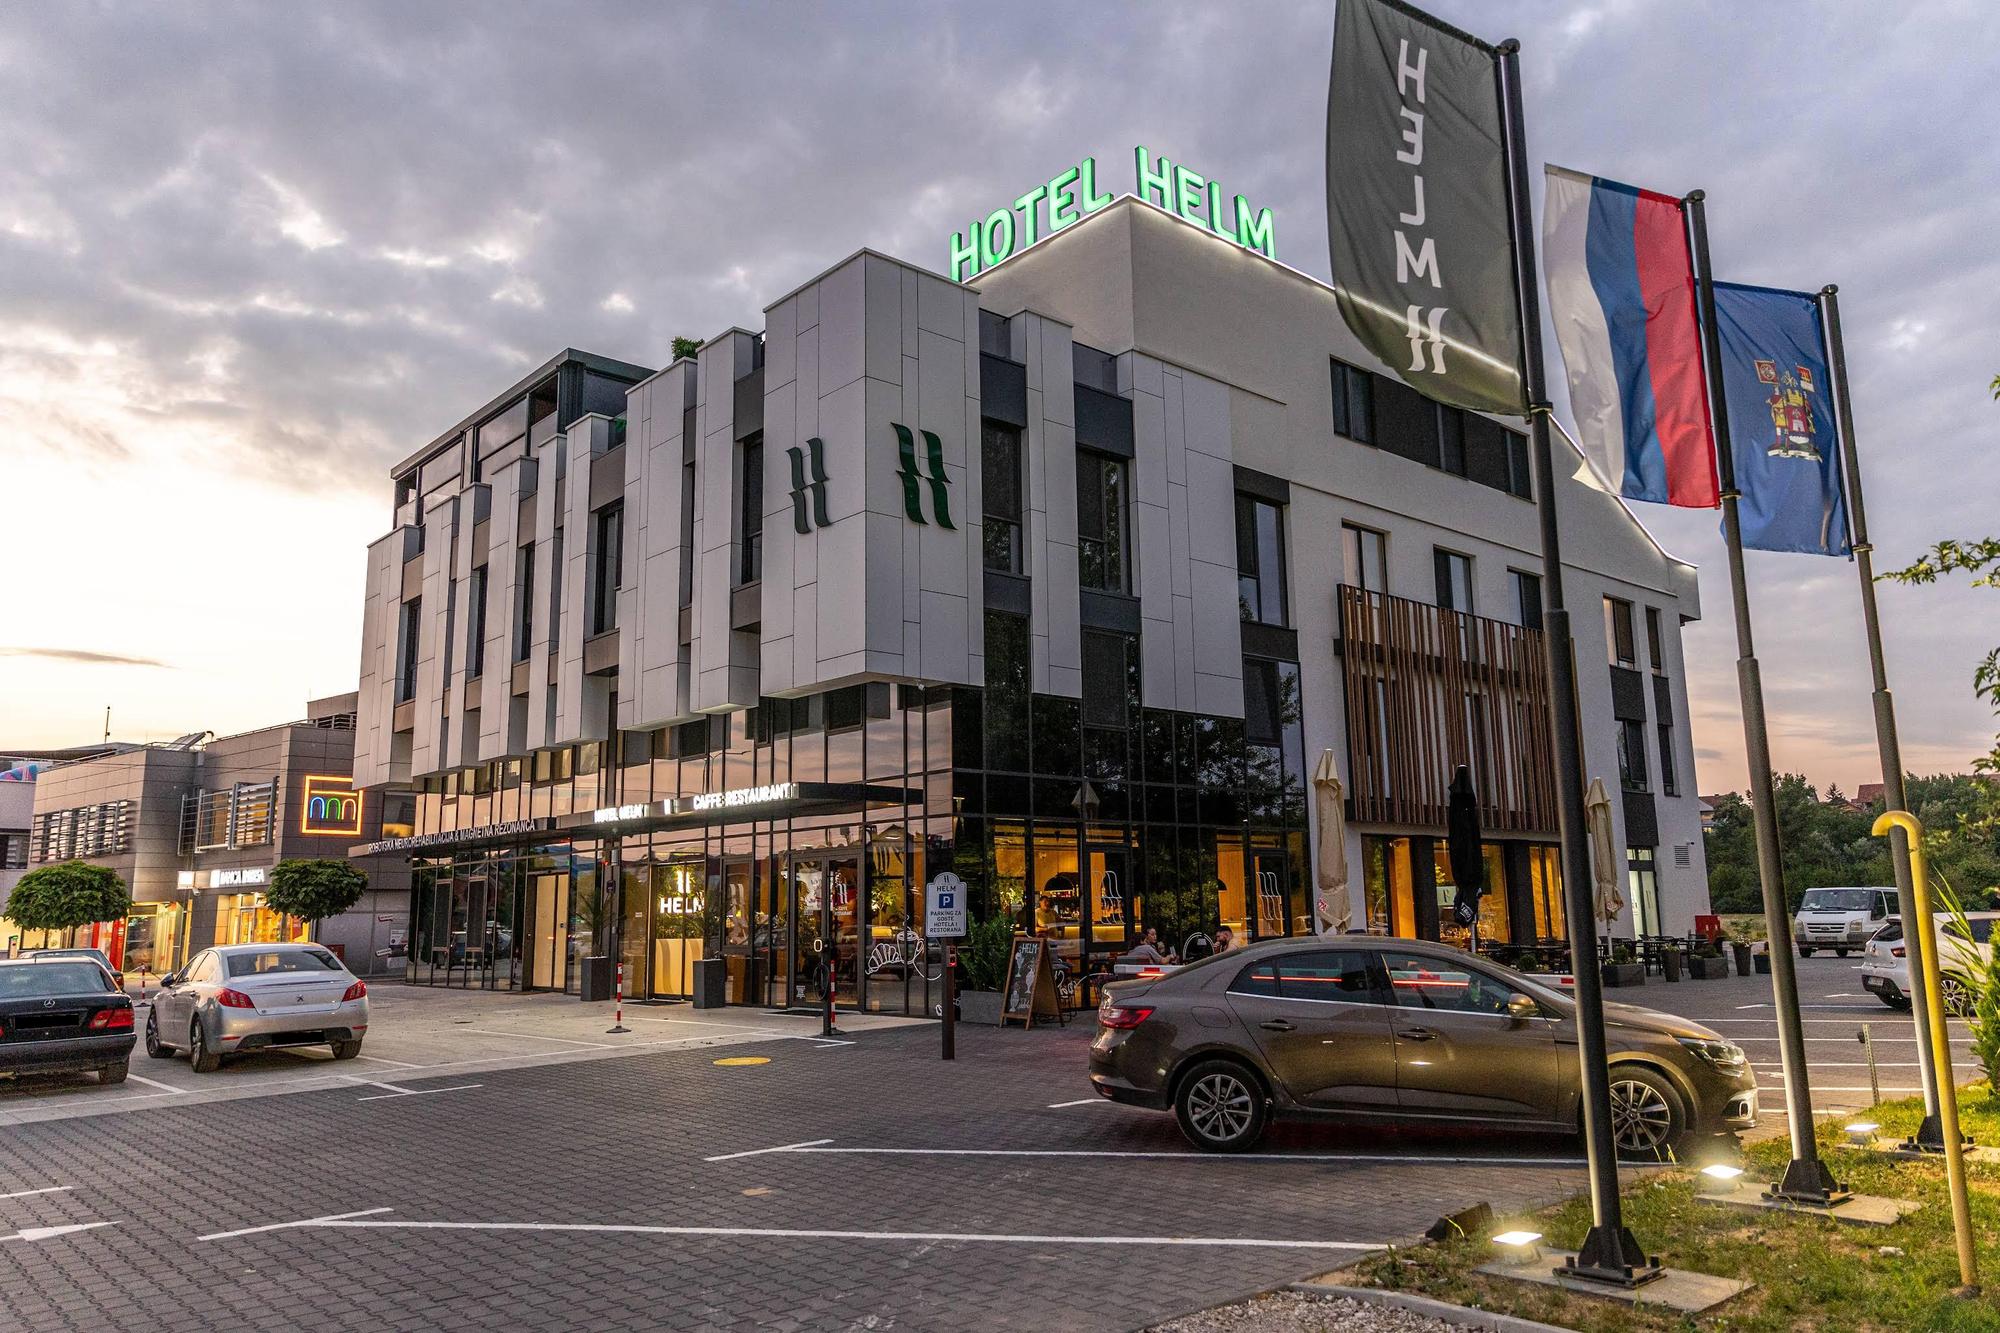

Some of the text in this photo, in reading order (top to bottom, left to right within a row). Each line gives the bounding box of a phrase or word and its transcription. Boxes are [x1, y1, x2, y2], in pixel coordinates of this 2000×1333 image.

[950, 145, 1276, 282] HOTEL HELM
[725, 783, 790, 806] RESTAURANT
[460, 824, 494, 840] MAGNETNA
[495, 819, 535, 836] REZONANCA
[943, 896, 951, 906] P
